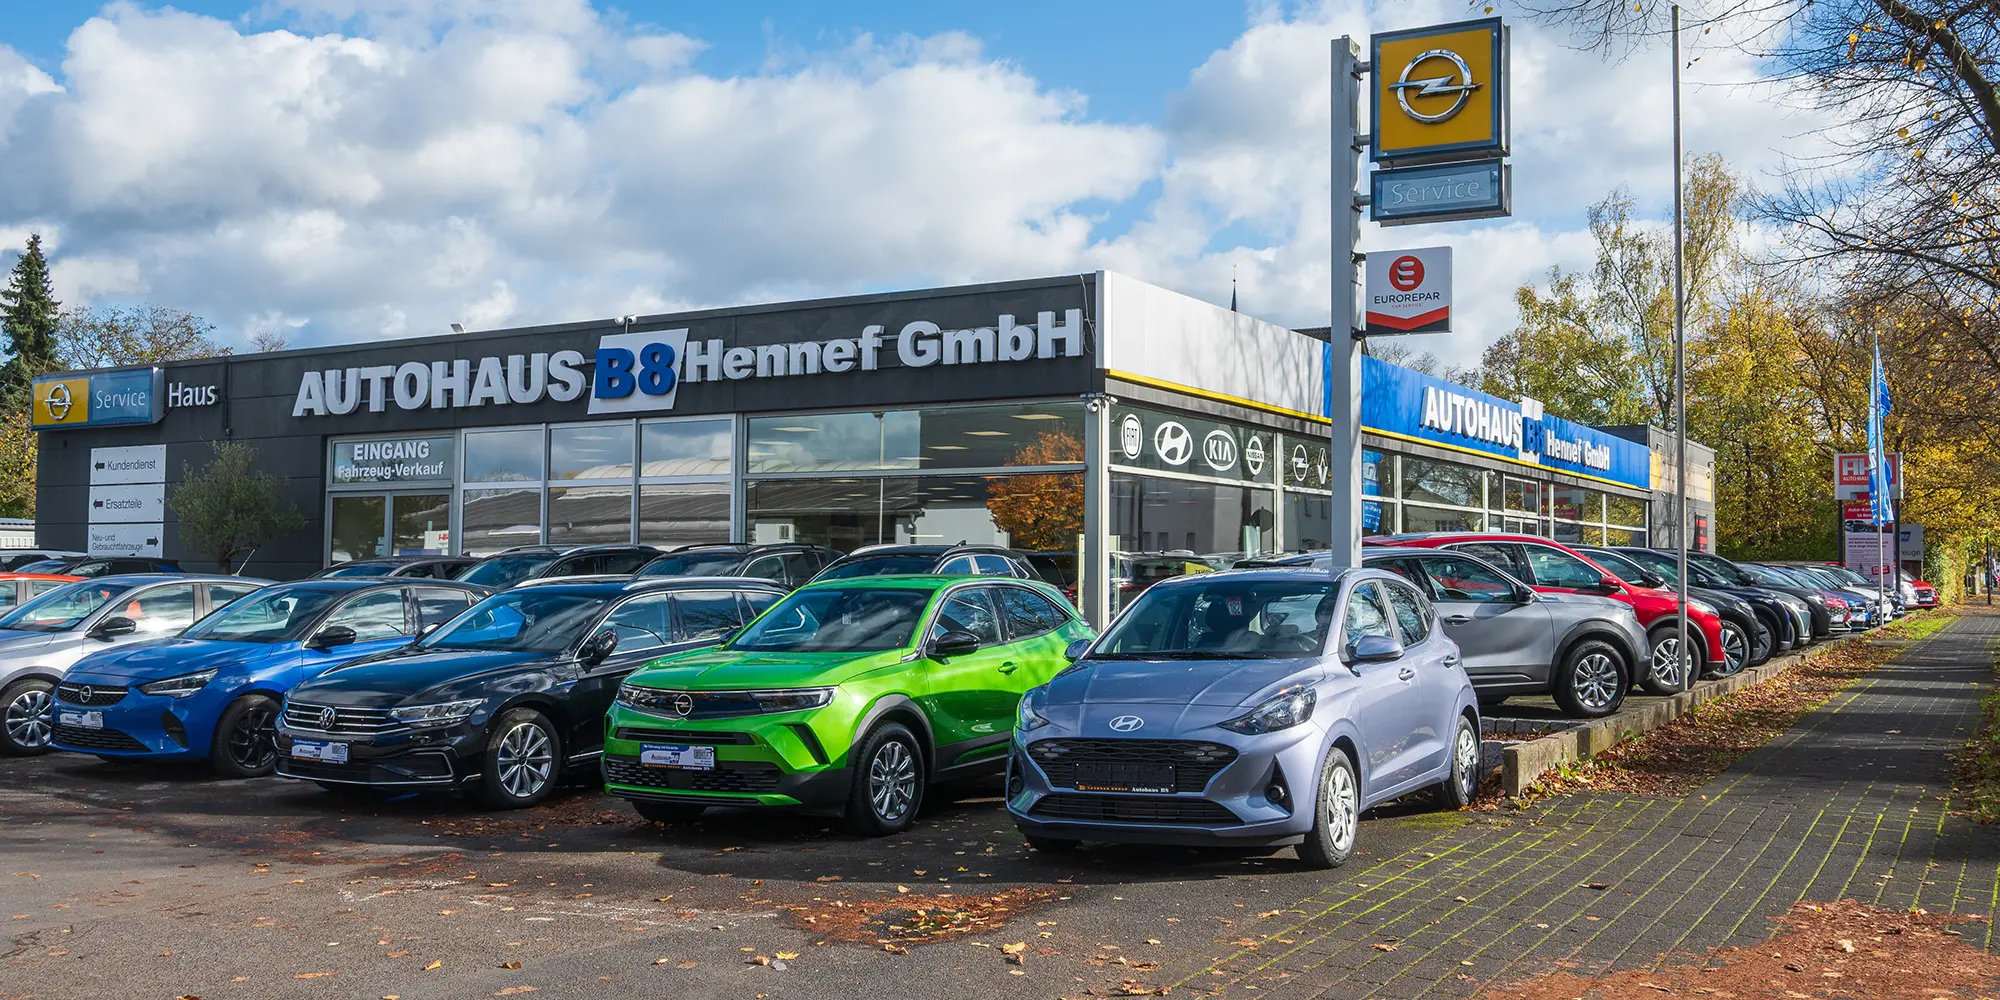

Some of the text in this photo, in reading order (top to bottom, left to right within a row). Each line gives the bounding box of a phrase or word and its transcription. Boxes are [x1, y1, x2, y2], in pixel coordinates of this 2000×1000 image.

[1391, 178, 1481, 206] Service
[1374, 291, 1440, 304] EUROREPAR
[292, 308, 1085, 417] AUTOHAUS B8 Hennef GmbH
[96, 381, 218, 409] Service Haus
[1420, 386, 1610, 471] AUTOHAUS B8 Hennef GmbH
[353, 441, 429, 461] EINGANG
[1208, 438, 1232, 462] KIA
[1246, 450, 1264, 461] NISSAN
[107, 459, 156, 471] Kundendienst
[338, 461, 444, 479] Fahrzeug-Verkauf
[105, 498, 142, 510] Ersatzteile
[92, 542, 143, 552] Gebrauchtfahrzeuge
